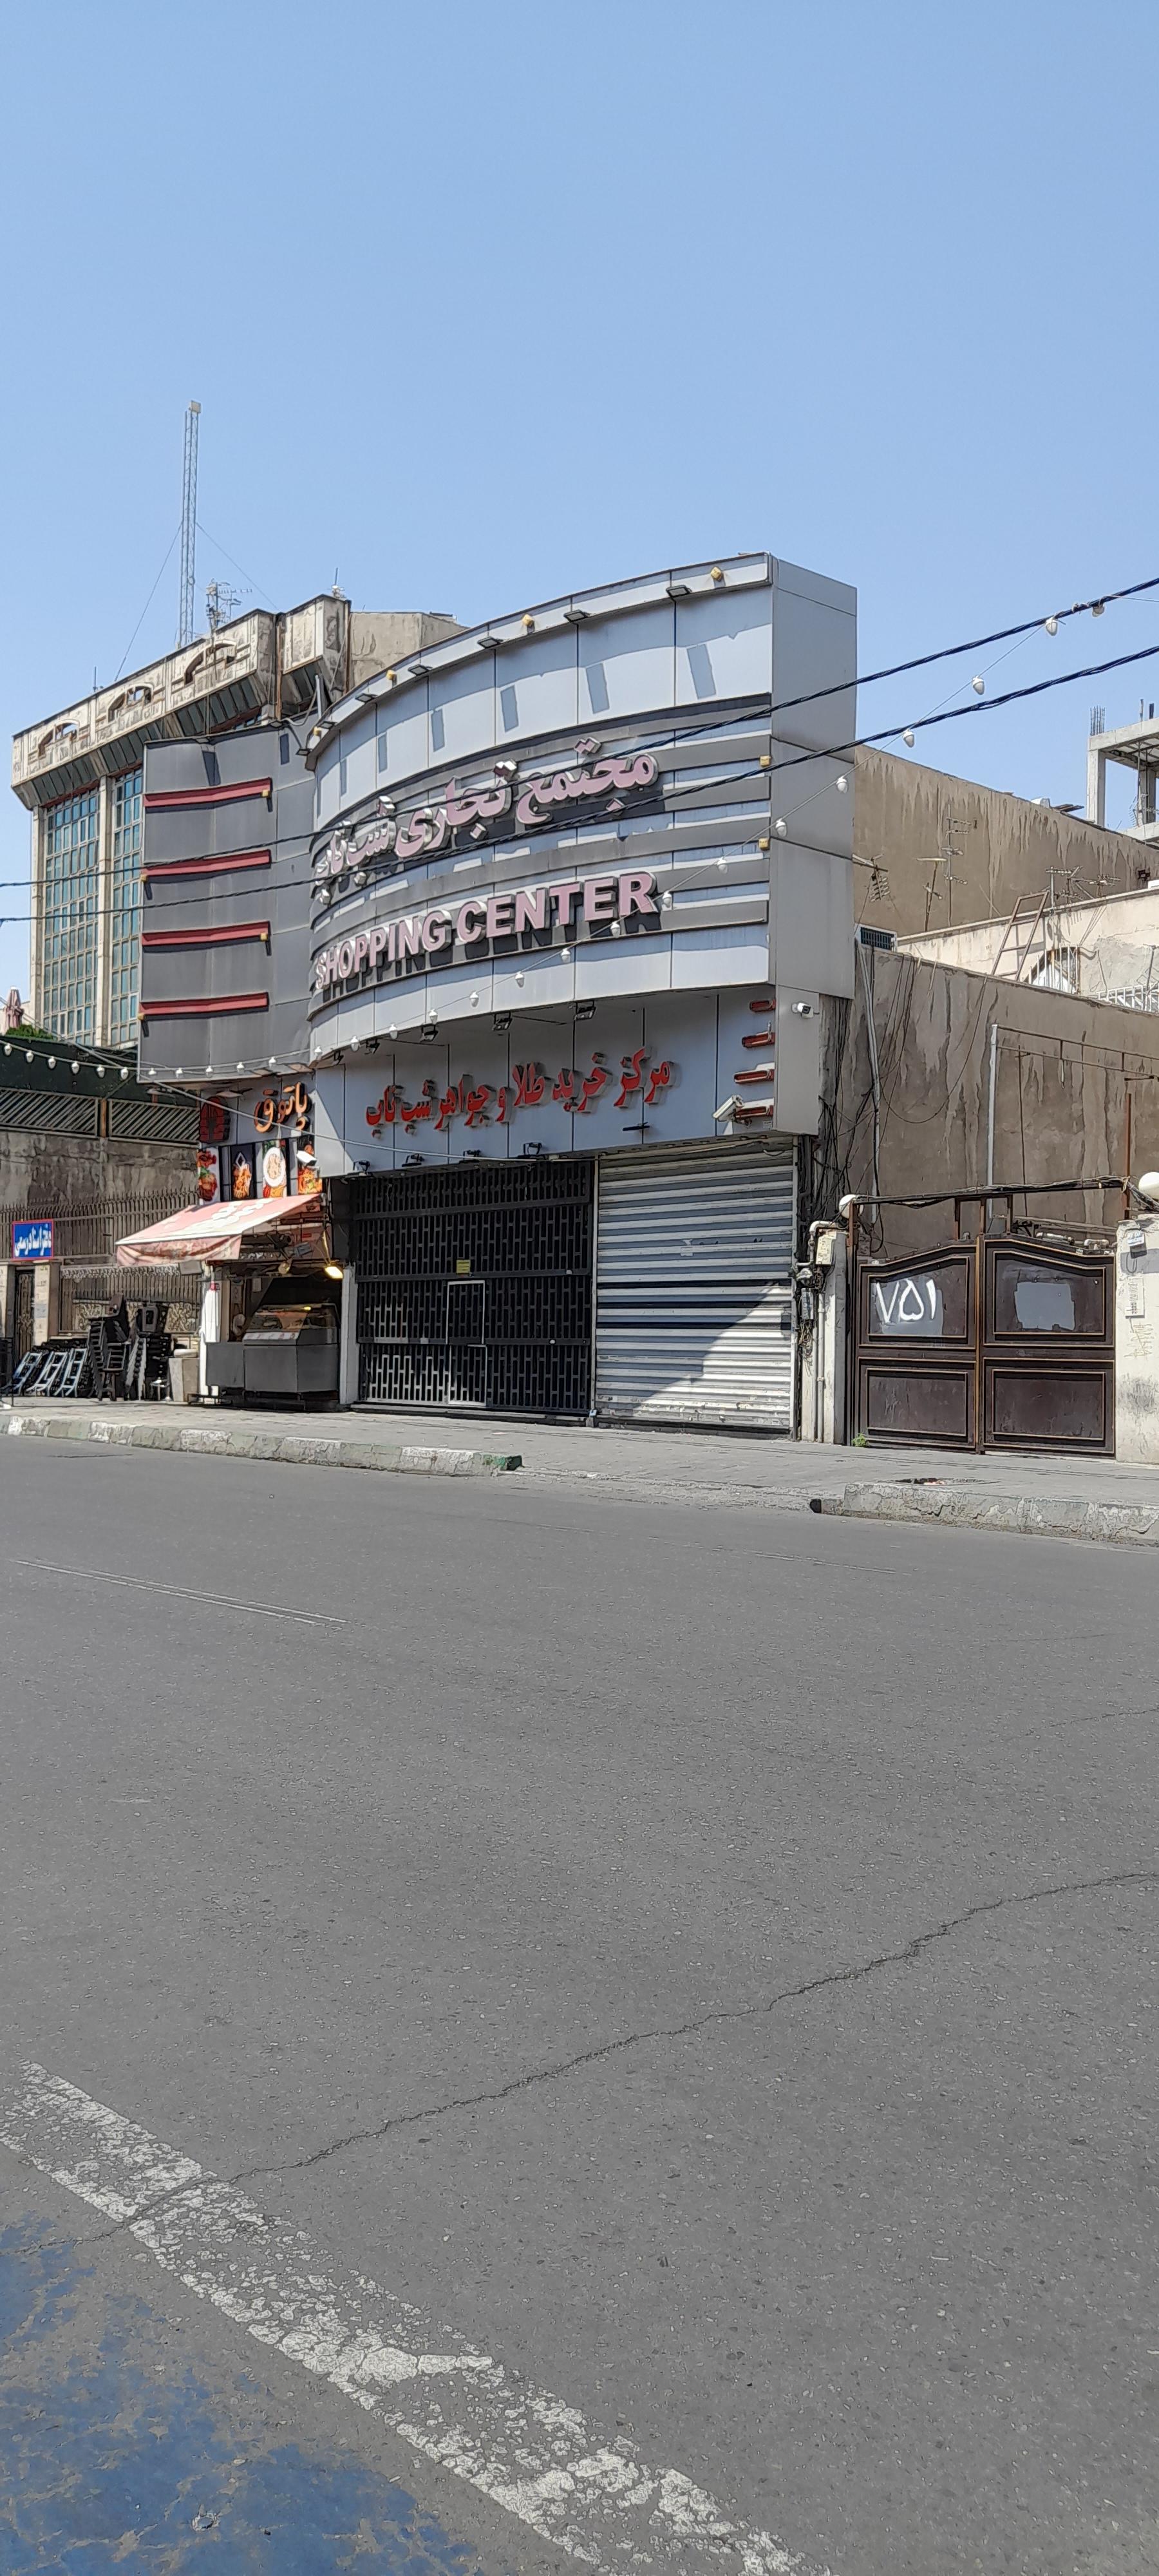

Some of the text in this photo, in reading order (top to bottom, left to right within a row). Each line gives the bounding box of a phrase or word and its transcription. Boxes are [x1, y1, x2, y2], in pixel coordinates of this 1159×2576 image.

[395, 759, 516, 858] تجاری
[516, 736, 659, 826] مجتمع
[314, 871, 659, 990] SHOPPING CENTER
[433, 1074, 493, 1130] جواهر
[495, 1086, 509, 1122] و
[512, 1062, 549, 1107] طلا
[552, 1052, 610, 1113] خرید
[613, 1046, 675, 1107] مرکز
[253, 1081, 310, 1134] پاتوق
[876, 1278, 936, 1324] ۷۵۱
